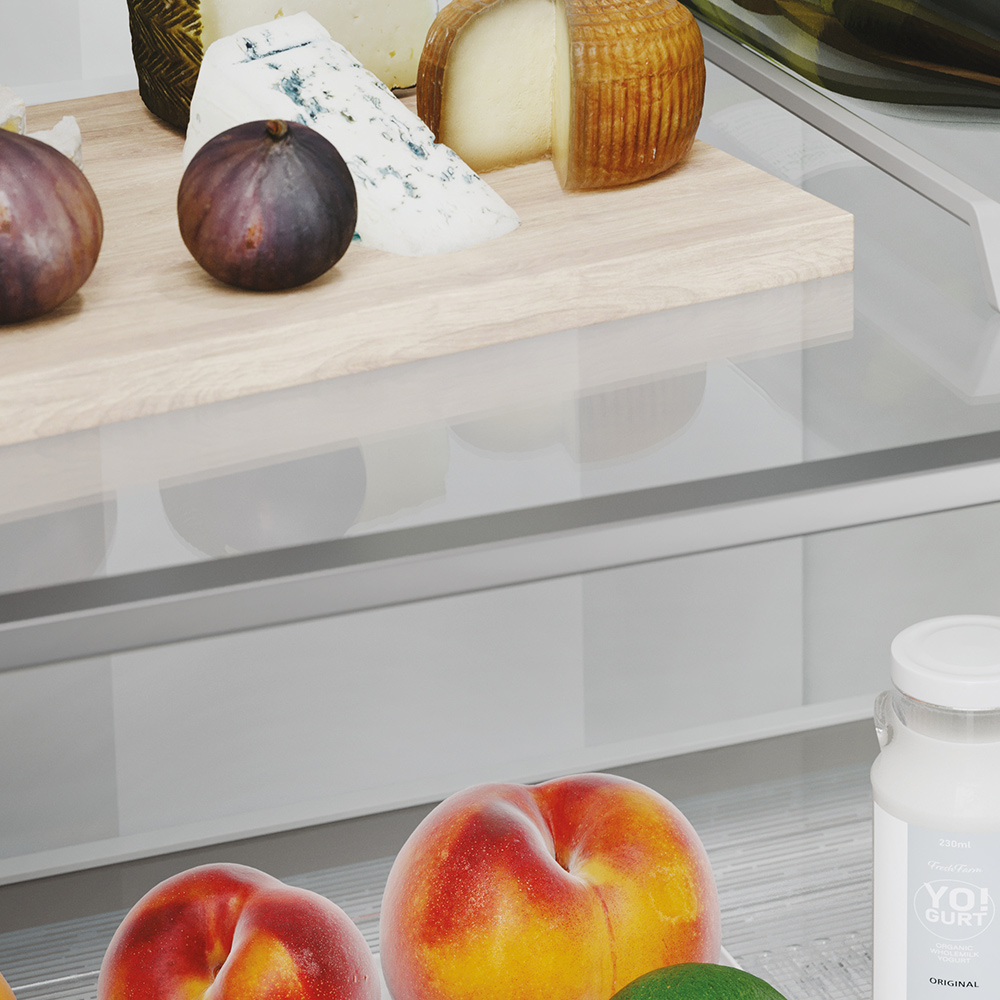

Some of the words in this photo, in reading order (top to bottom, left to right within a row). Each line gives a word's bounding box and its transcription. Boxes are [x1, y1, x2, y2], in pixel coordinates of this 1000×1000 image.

[938, 838, 972, 849] 230ml
[923, 881, 989, 912] YO!
[925, 908, 988, 927] GURT
[935, 942, 974, 952] ORGANIC
[937, 955, 971, 965] YOGURT
[928, 976, 980, 989] ORIGINAL
